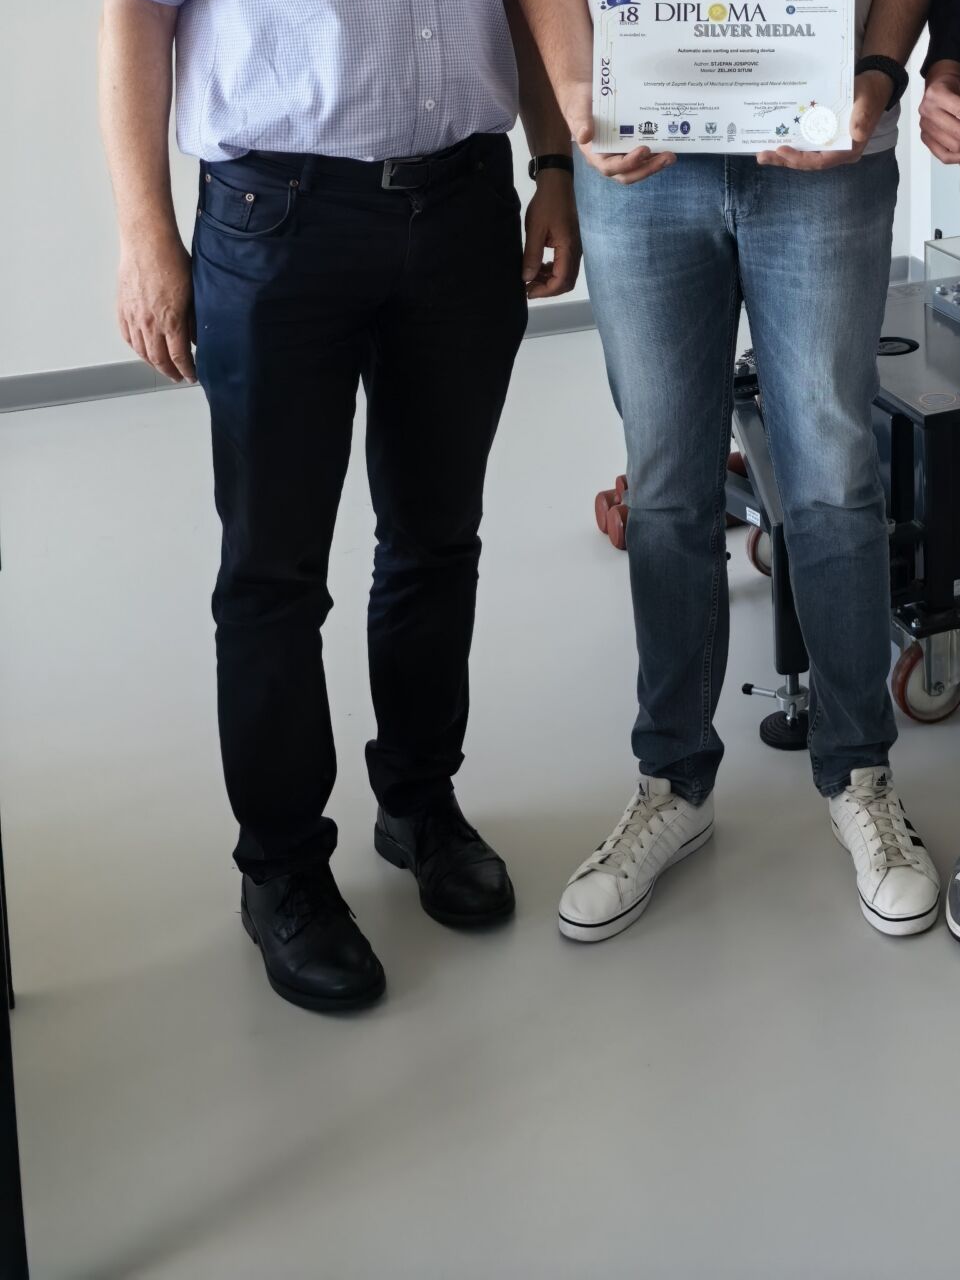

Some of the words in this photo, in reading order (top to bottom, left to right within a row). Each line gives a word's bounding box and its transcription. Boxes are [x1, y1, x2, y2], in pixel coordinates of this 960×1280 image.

[619, 6, 639, 23] 18
[694, 23, 752, 38] SILVER
[755, 23, 816, 37] MEDAL
[601, 57, 614, 97] 2026
